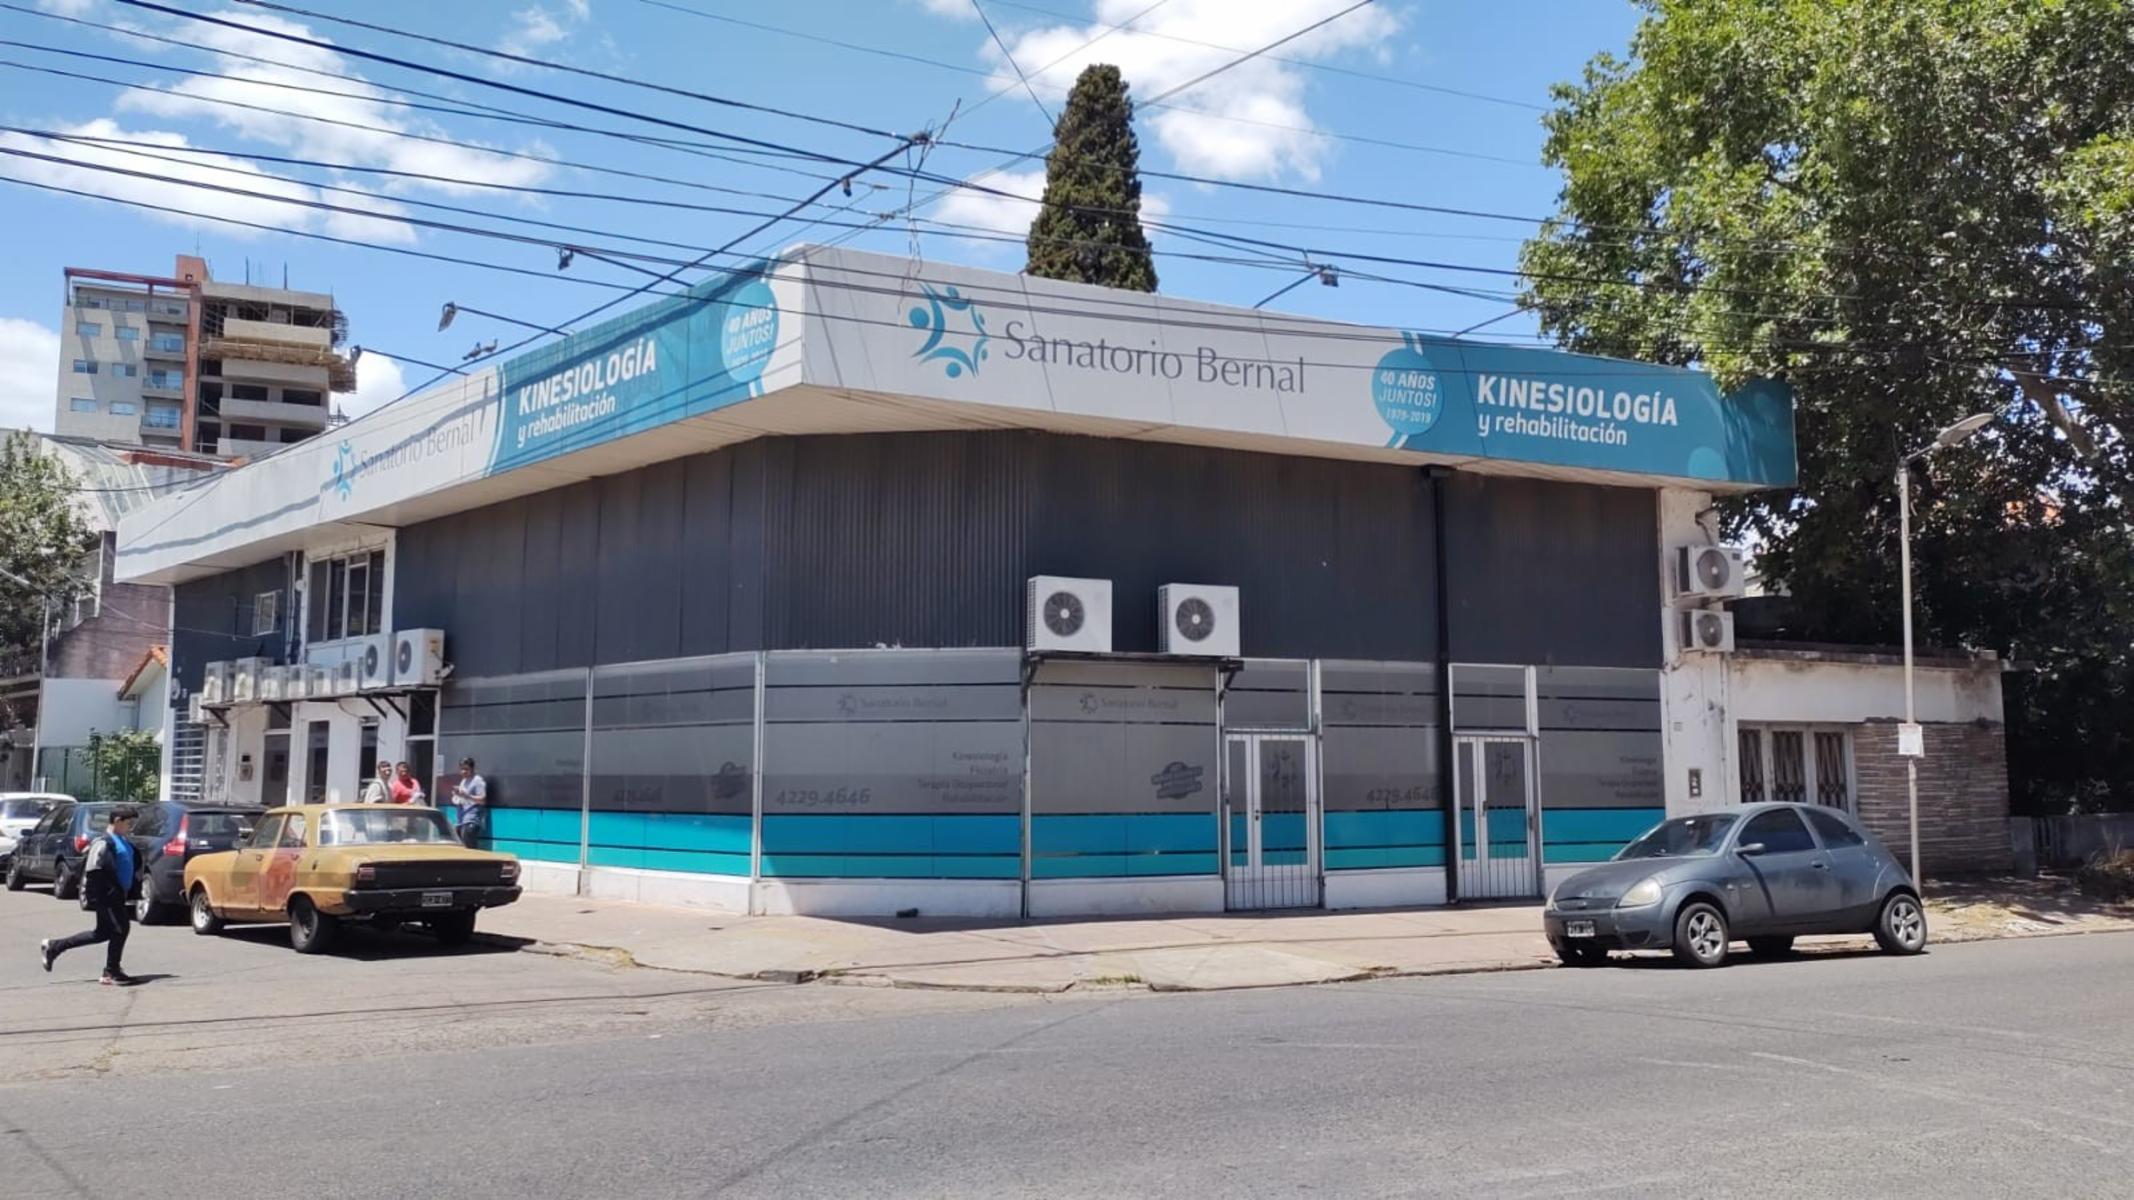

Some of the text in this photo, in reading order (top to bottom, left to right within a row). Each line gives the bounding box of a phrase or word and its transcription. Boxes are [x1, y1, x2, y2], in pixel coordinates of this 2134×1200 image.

[518, 338, 657, 416] KINESIOLOGÍA
[1004, 320, 1305, 393] Sanatorio Bernal
[1398, 371, 1436, 390] AÑOS
[517, 394, 616, 448] y rehabilitación
[1379, 387, 1438, 408] JUNTOS!
[1477, 374, 1679, 426] KINESIOLOGÍA
[359, 409, 475, 479] Sanatorio Bernal
[1478, 414, 1628, 446] y rehabilitación
[774, 786, 872, 807] 4229.4646
